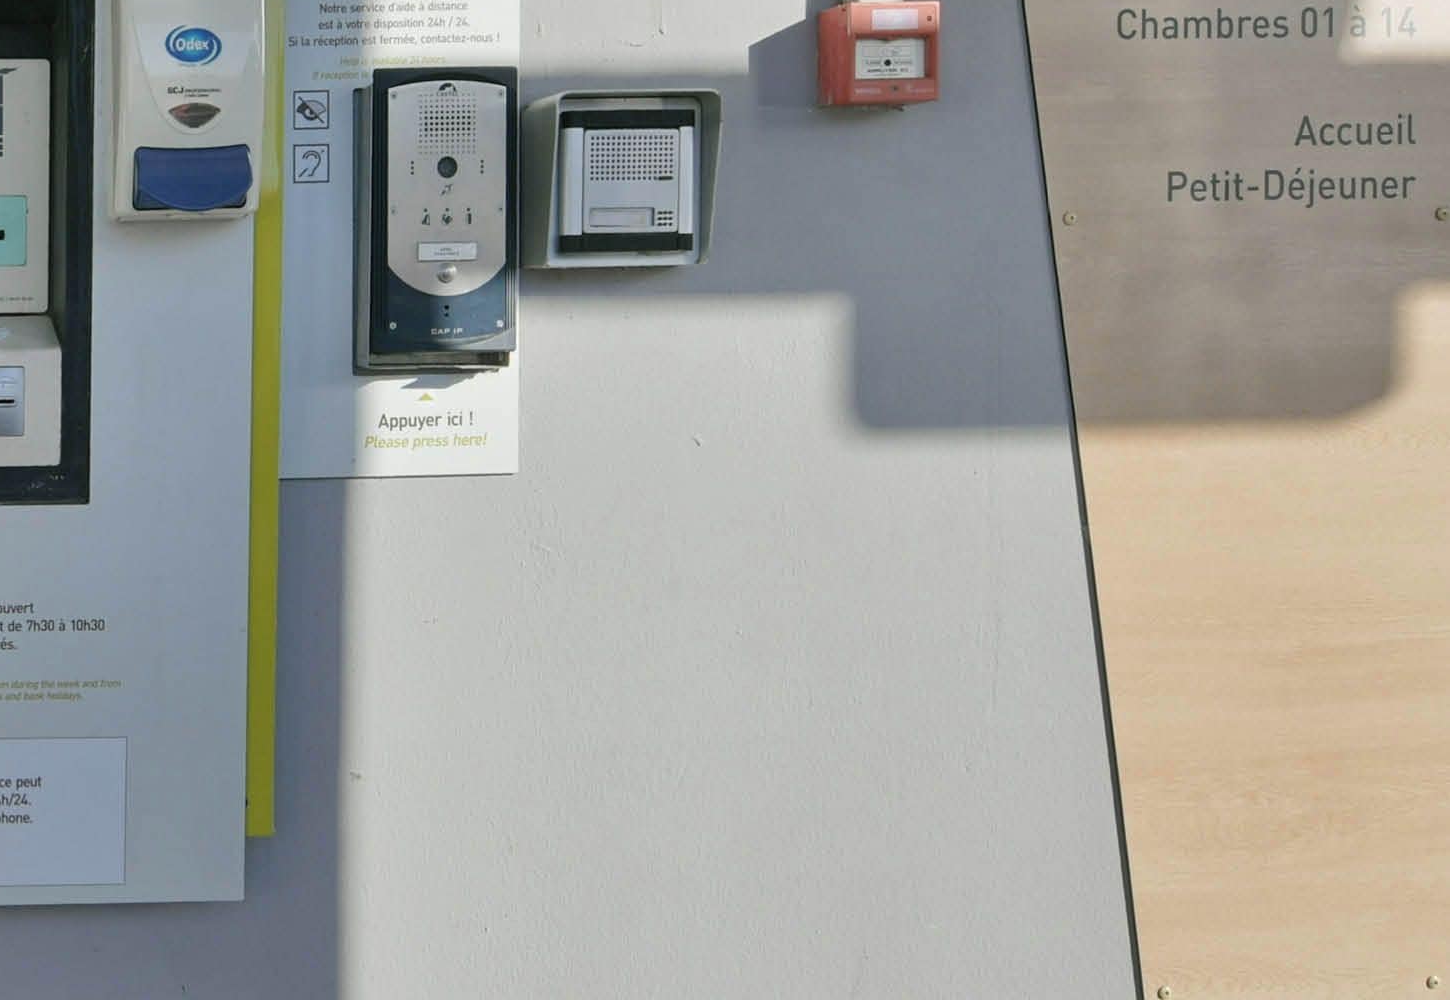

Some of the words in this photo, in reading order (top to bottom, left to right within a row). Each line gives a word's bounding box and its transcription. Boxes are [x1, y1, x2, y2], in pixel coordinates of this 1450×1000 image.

[1117, 8, 1289, 40] Chambres
[1301, 6, 1333, 38] 01
[1350, 6, 1366, 38] à
[1382, 6, 1417, 40] 14
[288, 36, 298, 48] Si
[300, 36, 310, 46] la
[313, 33, 360, 48] réception
[362, 36, 376, 46] est
[380, 34, 416, 46] fermée,
[420, 34, 493, 44] contactez-nous
[1294, 113, 1416, 146] Accueil
[1168, 168, 1416, 208] Petit-Déjeuner
[378, 414, 442, 431] Appuyer
[445, 411, 462, 426] ici
[470, 411, 473, 426] !
[364, 436, 409, 448] Please
[411, 436, 449, 451] press
[452, 432, 487, 448] here!
[7, 620, 22, 632] de
[26, 619, 55, 632] 7h30
[58, 618, 66, 632] à
[70, 618, 105, 632] 10h30
[16, 776, 42, 792] peut
